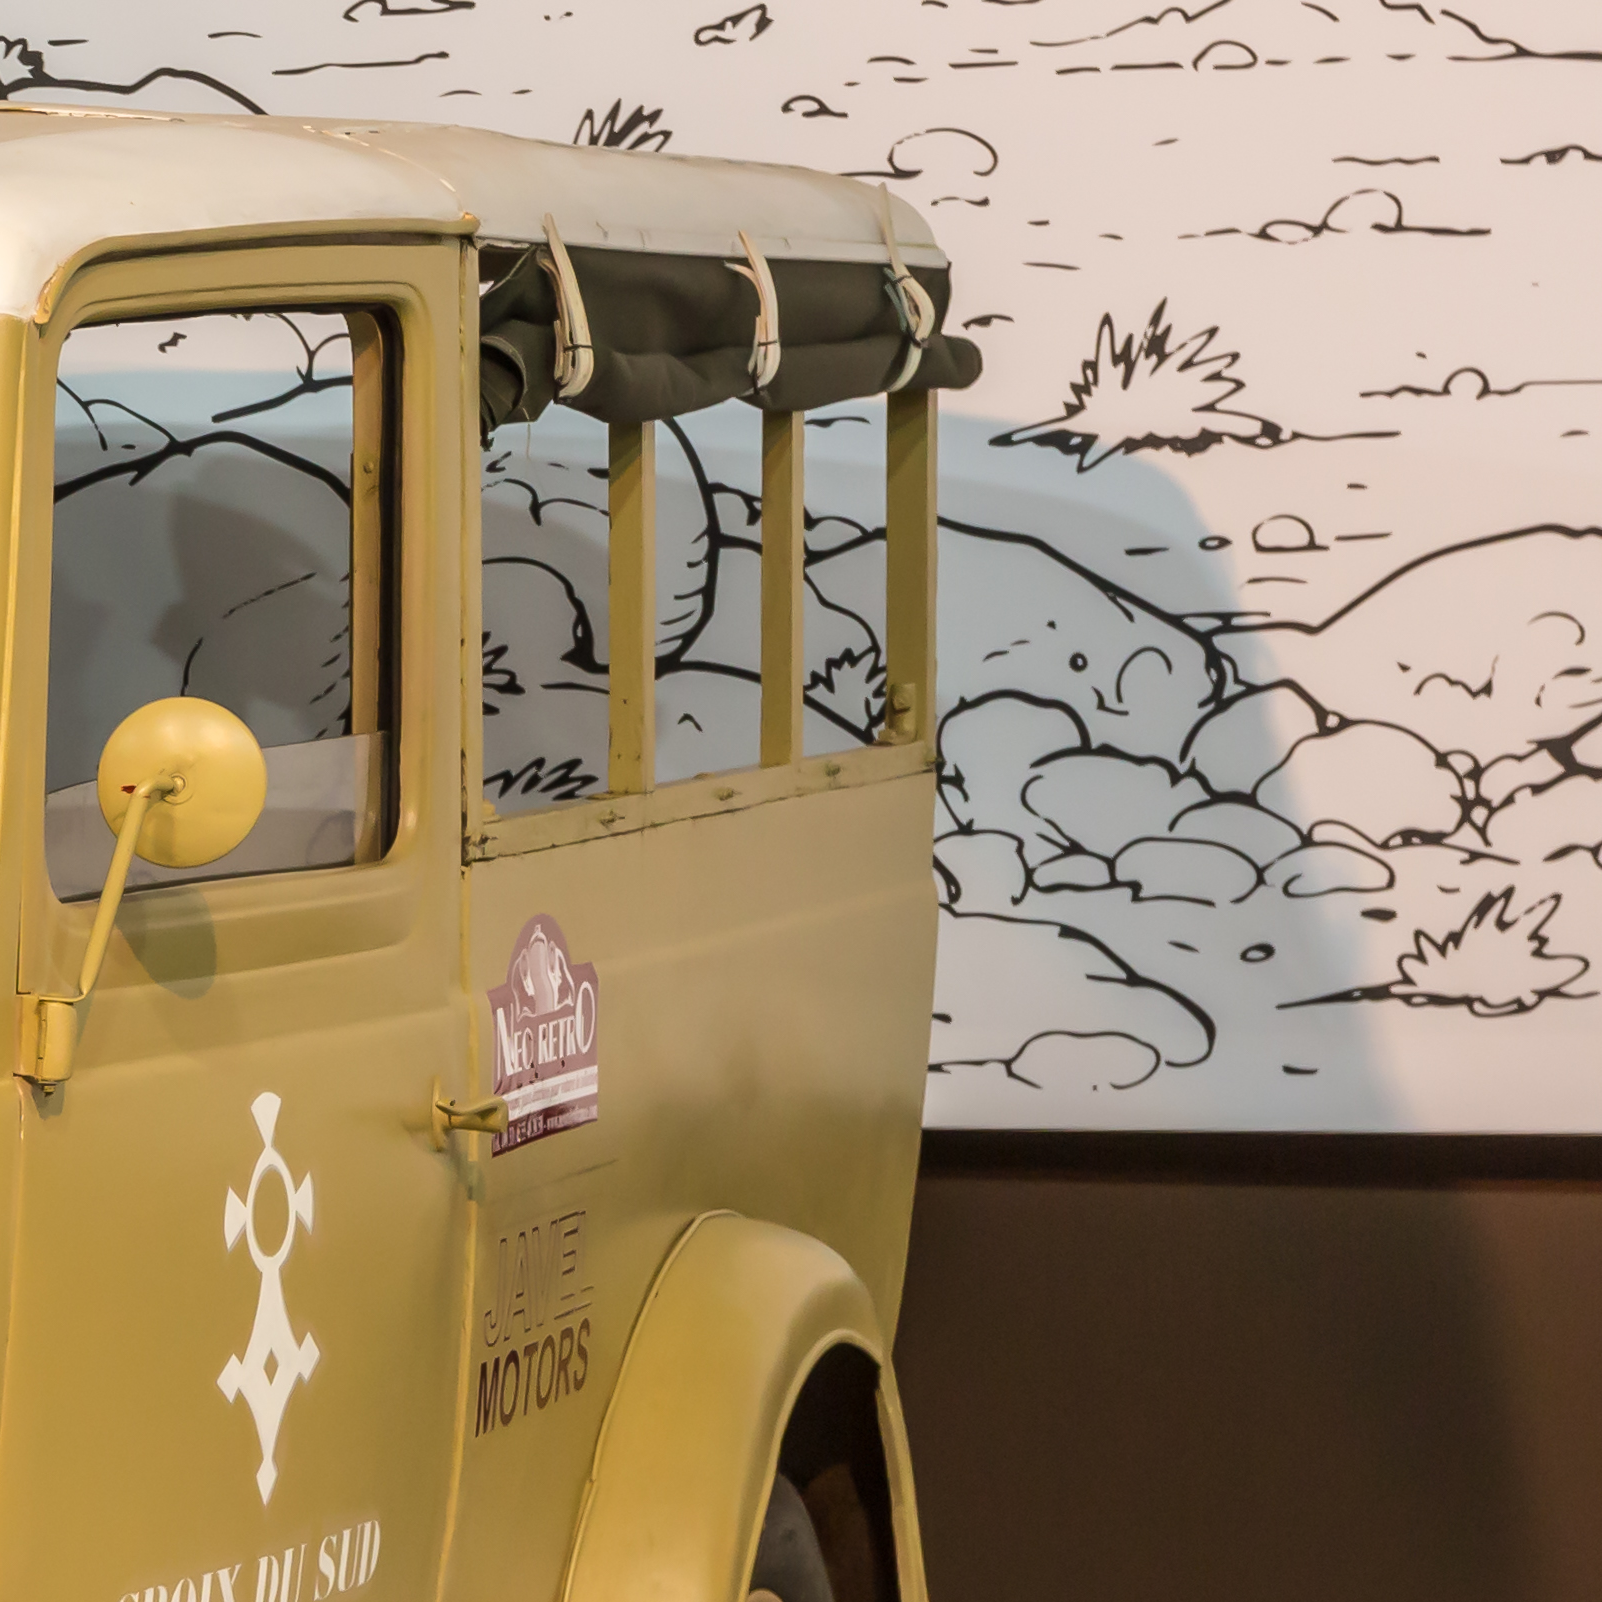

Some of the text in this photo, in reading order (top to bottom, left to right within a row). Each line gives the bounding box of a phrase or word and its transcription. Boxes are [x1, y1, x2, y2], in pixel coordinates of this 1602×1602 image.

[538, 981, 596, 1065] RETRO
[475, 1317, 591, 1438] MOTORS
[314, 1519, 382, 1602] SUD
